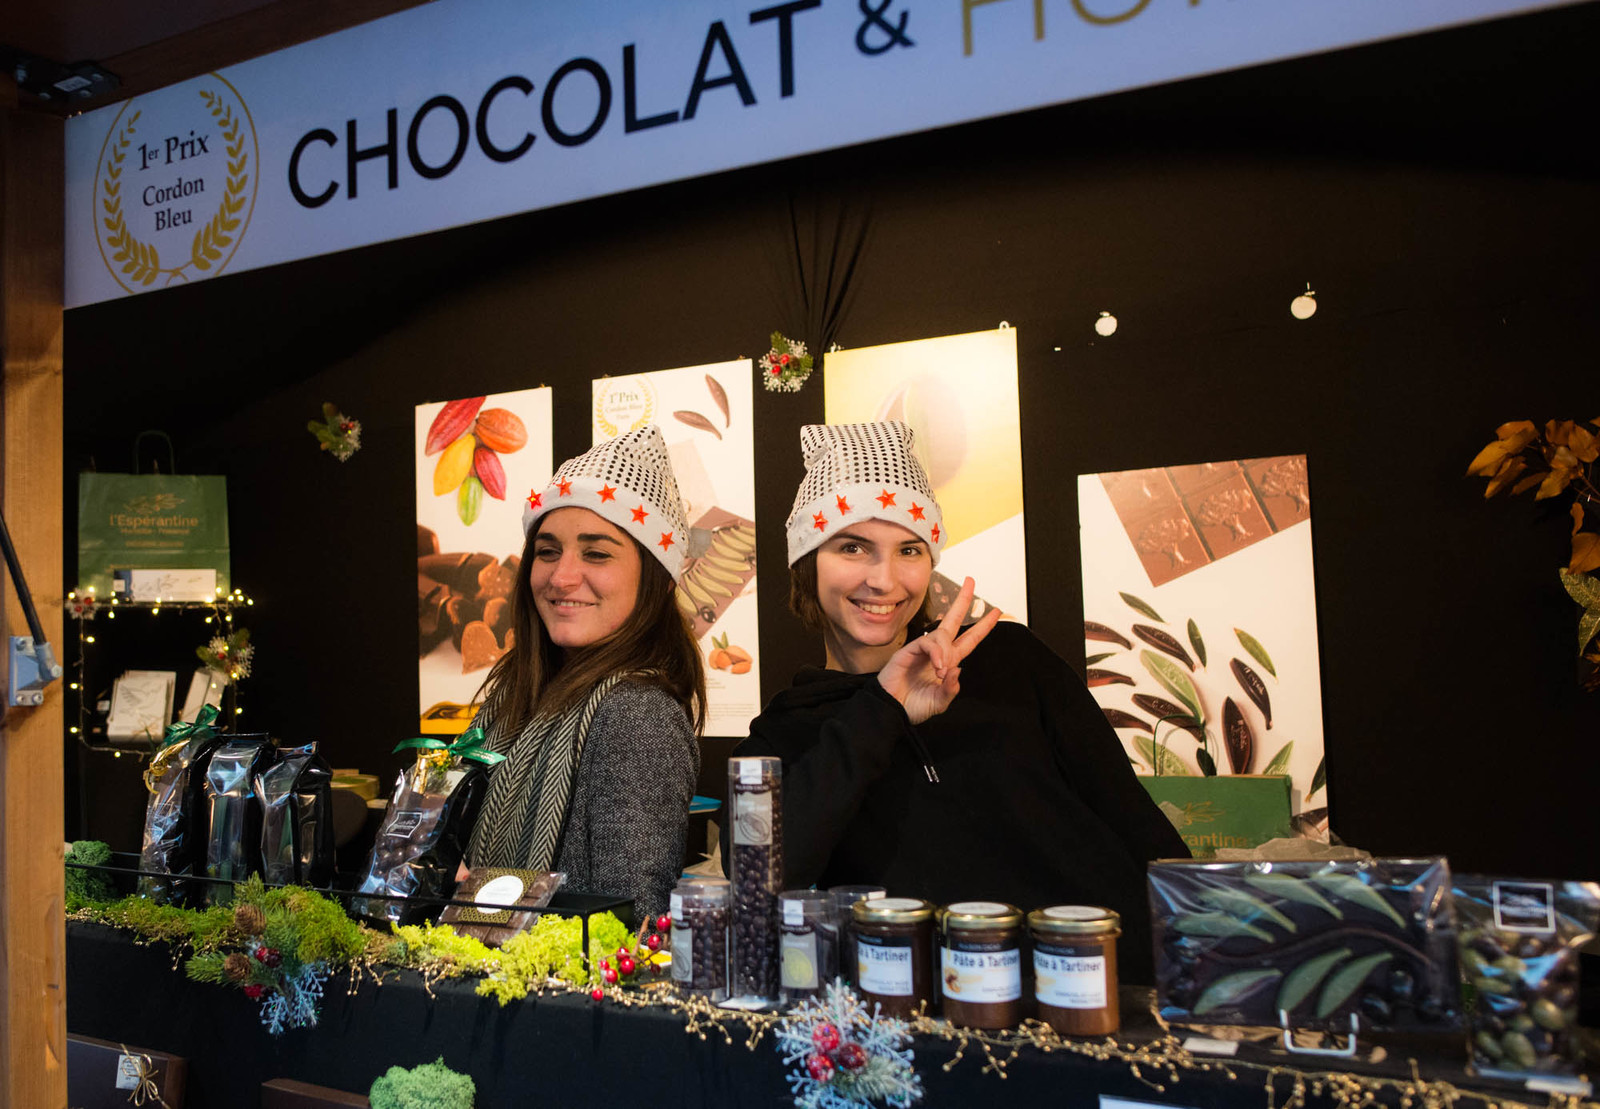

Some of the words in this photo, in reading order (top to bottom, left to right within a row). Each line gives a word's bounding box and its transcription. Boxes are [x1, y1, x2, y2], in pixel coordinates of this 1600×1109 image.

[288, 0, 822, 209] CHOCOLAT
[855, 0, 916, 56] &
[138, 143, 159, 170] 1er
[164, 130, 210, 164] Prix
[142, 177, 205, 207] Cordon
[155, 208, 193, 232] Bleu
[1182, 832, 1247, 849] rantine
[953, 953, 976, 967] Pâte
[1060, 959, 1100, 972] Tartiner
